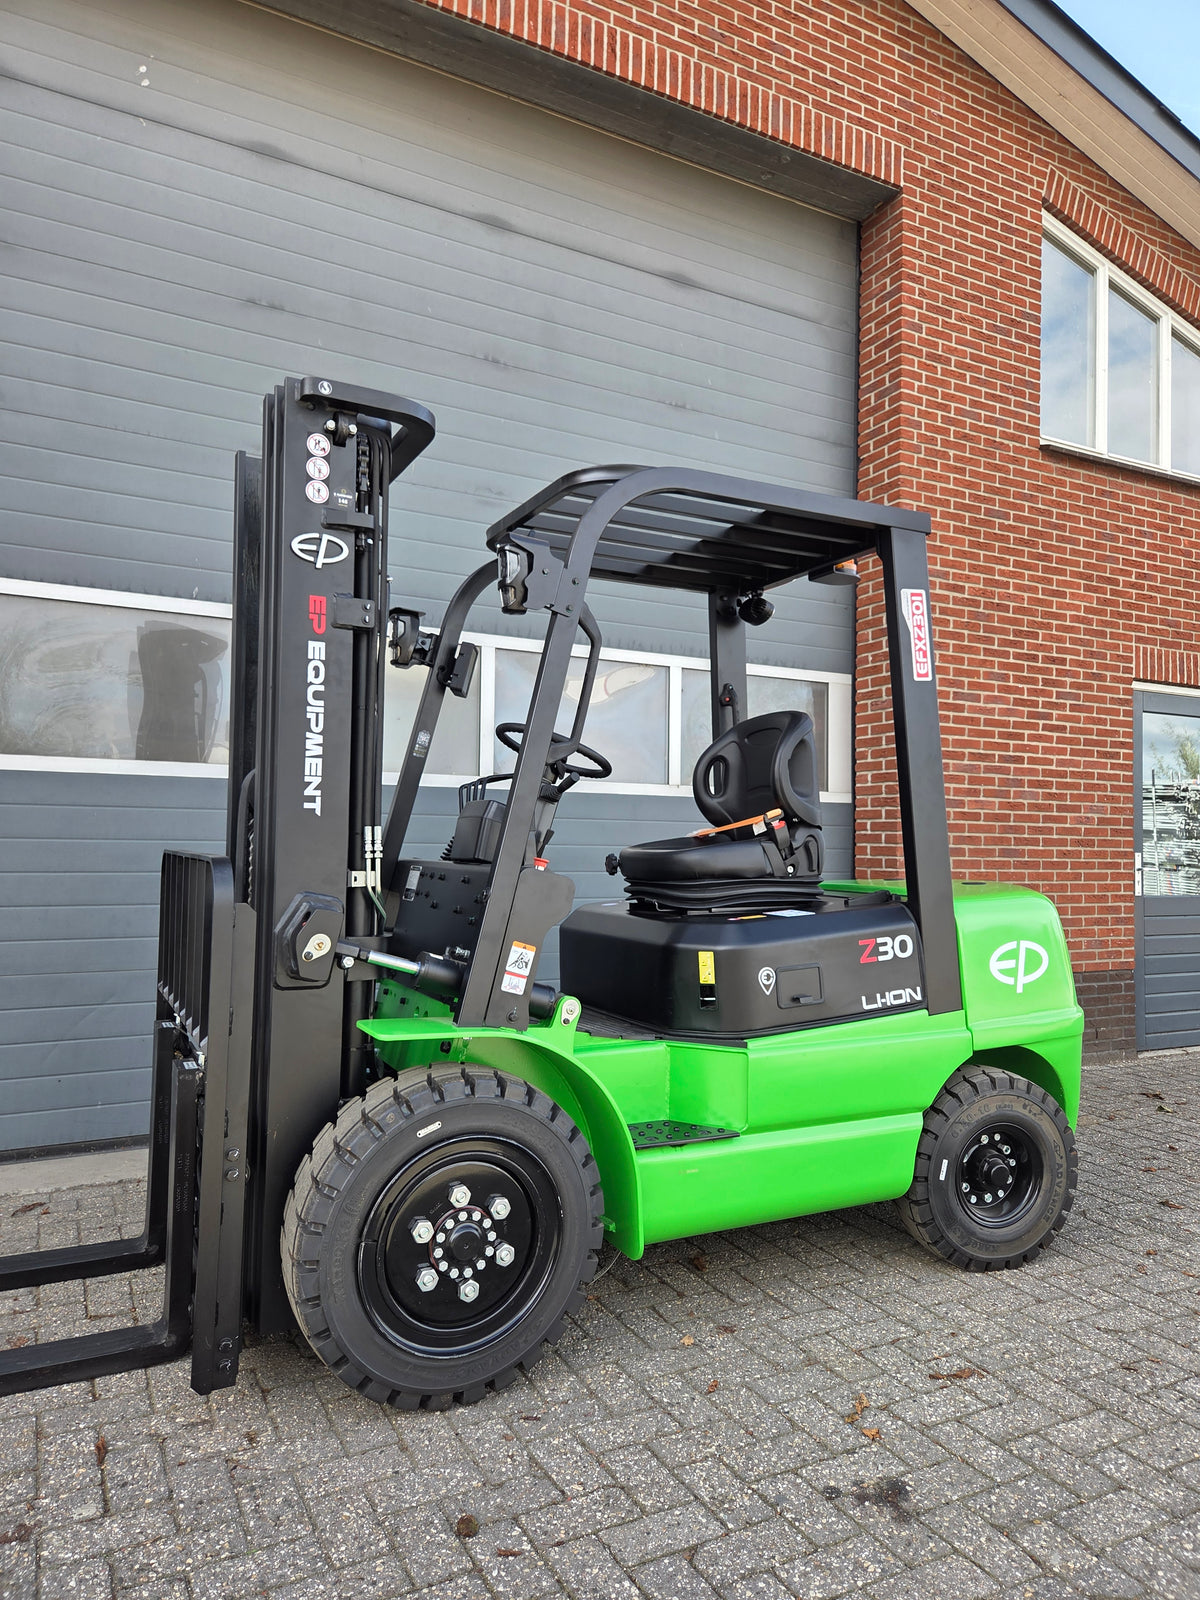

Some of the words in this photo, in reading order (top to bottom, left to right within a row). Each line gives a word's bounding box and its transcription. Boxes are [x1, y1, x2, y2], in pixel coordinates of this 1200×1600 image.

[290, 532, 350, 569] EP
[308, 595, 327, 635] EP
[303, 640, 327, 817] EQUIPMENT
[858, 934, 914, 964] Z30
[988, 939, 1050, 994] EP
